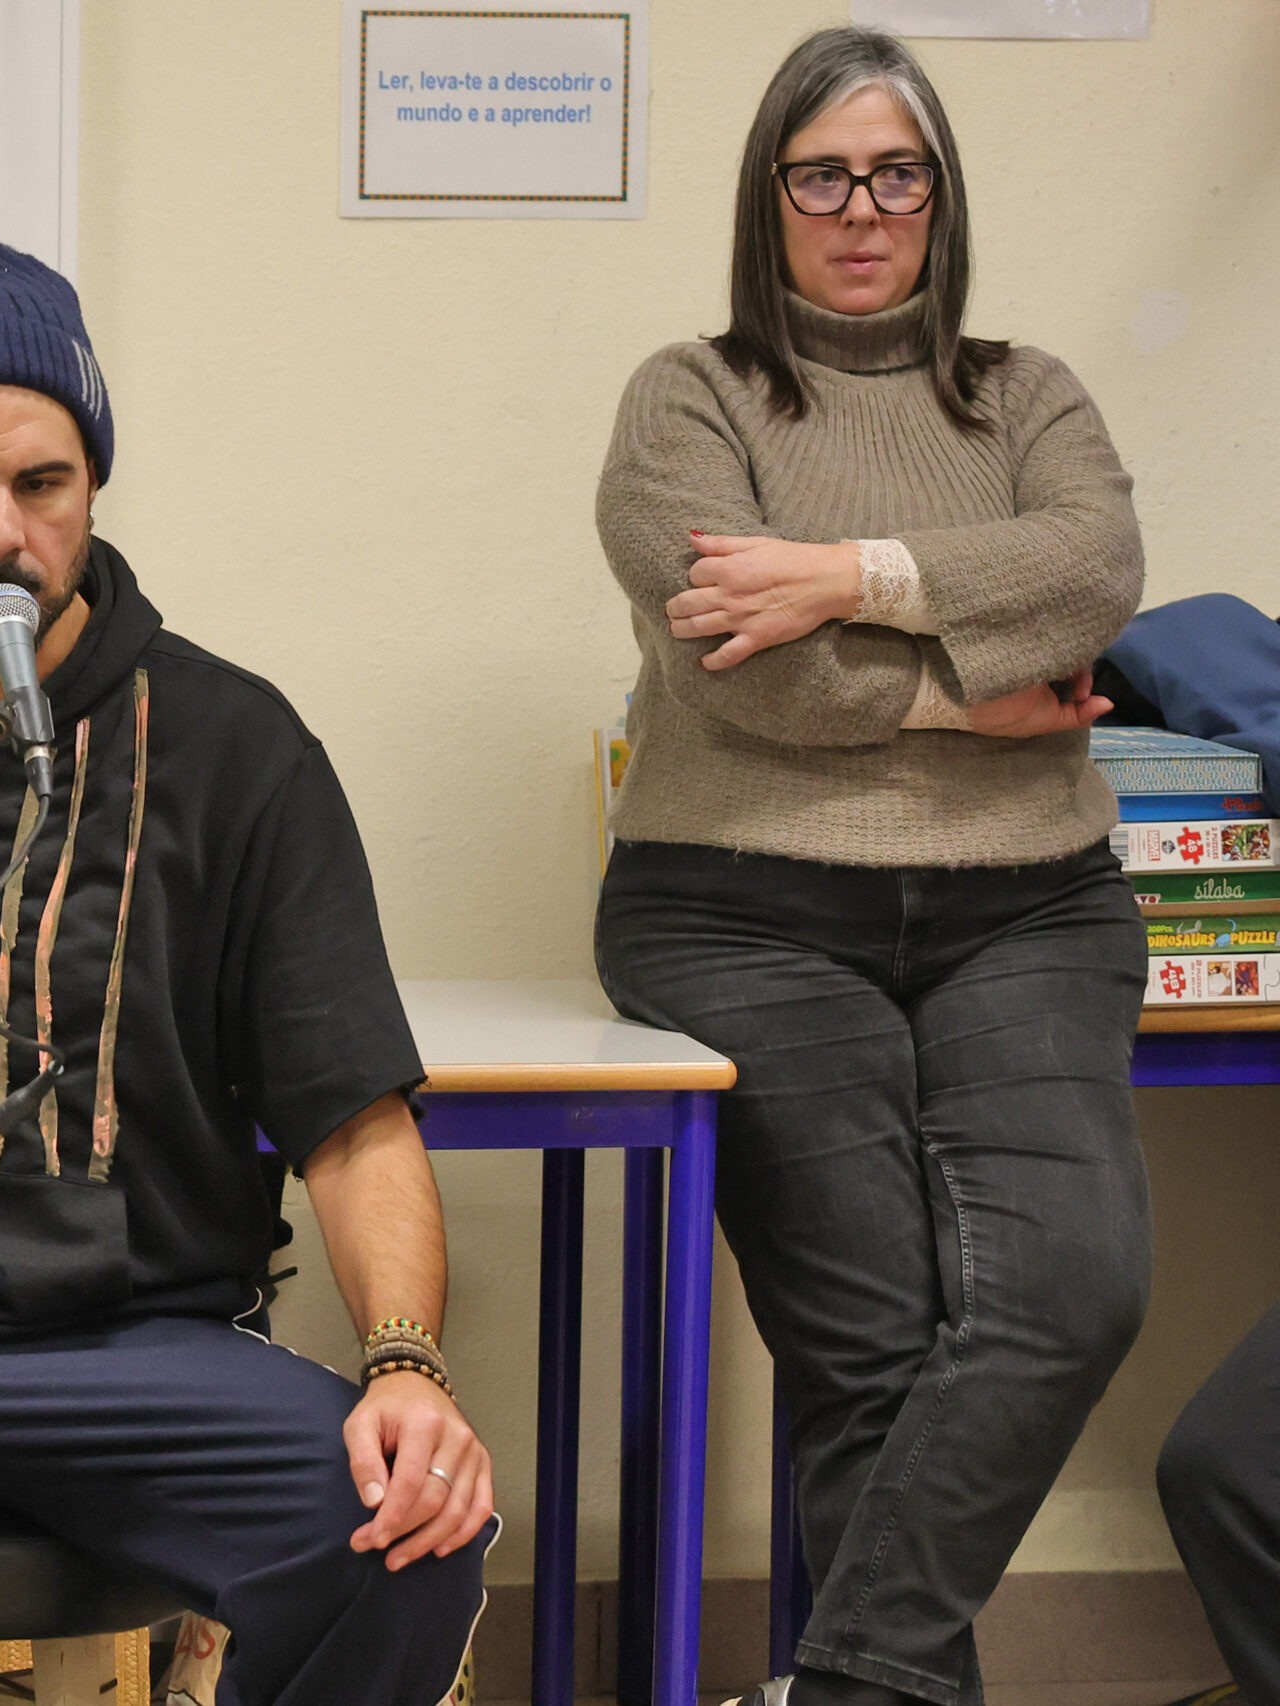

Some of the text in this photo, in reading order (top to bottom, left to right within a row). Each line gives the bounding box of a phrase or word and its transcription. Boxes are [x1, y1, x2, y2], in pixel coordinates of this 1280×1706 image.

[379, 71, 612, 93] Ler, leva-te a descobrir o
[397, 103, 591, 126] mundo e a aprender!
[1147, 830, 1161, 861] MARVEL
[1187, 839, 1198, 853] 48
[1147, 931, 1276, 948] DINOSAURS PUZZLE
[1168, 969, 1180, 990] 48
